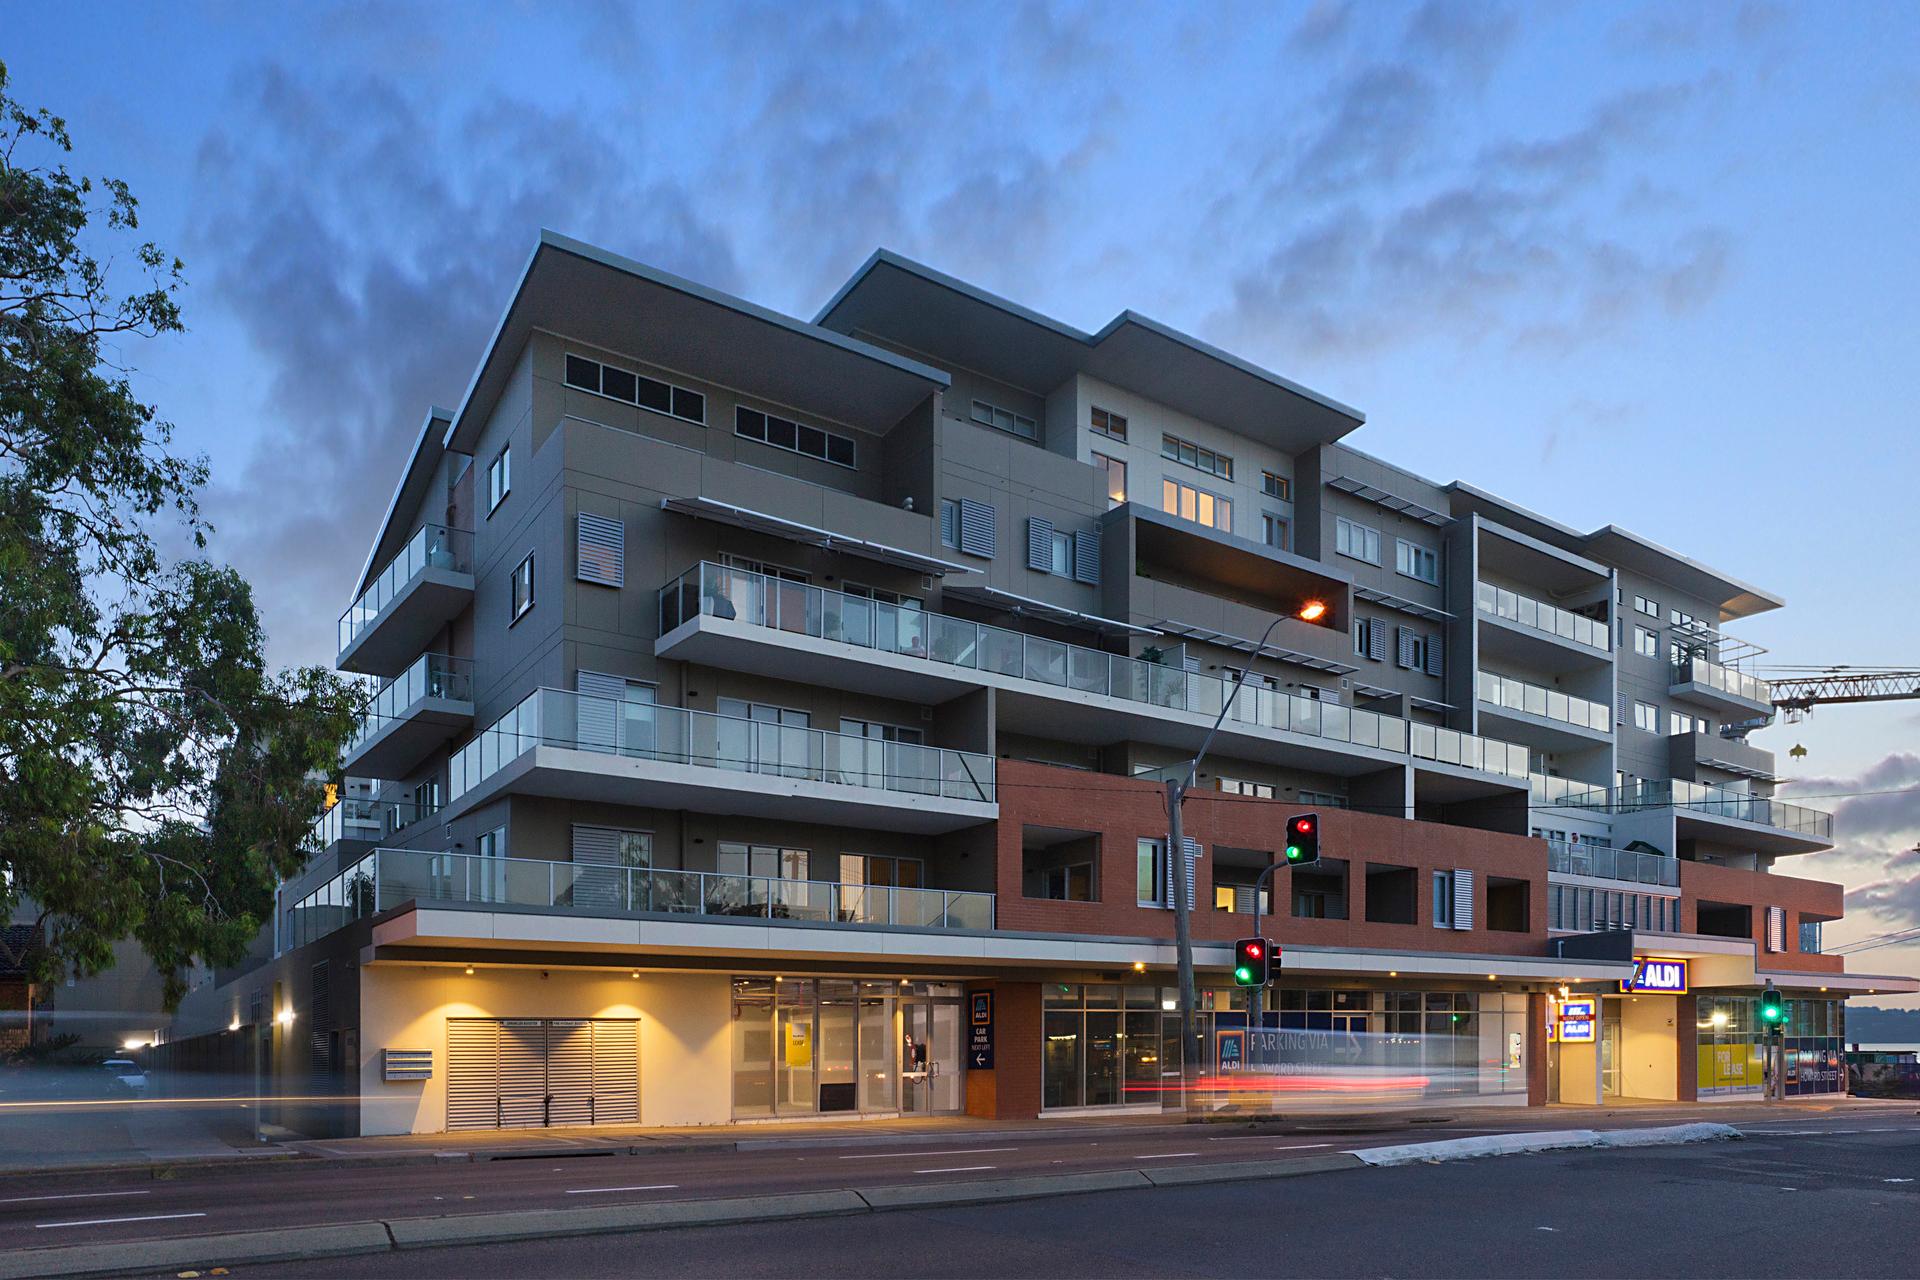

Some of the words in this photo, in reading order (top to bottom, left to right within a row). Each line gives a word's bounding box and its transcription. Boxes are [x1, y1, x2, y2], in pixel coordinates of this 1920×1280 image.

[1645, 964, 1680, 988] ALDI
[1308, 1033, 1329, 1049] VIA
[1717, 1051, 1730, 1063] FOR
[1221, 1060, 1240, 1070] ALDI
[1724, 1064, 1743, 1075] LEASE
